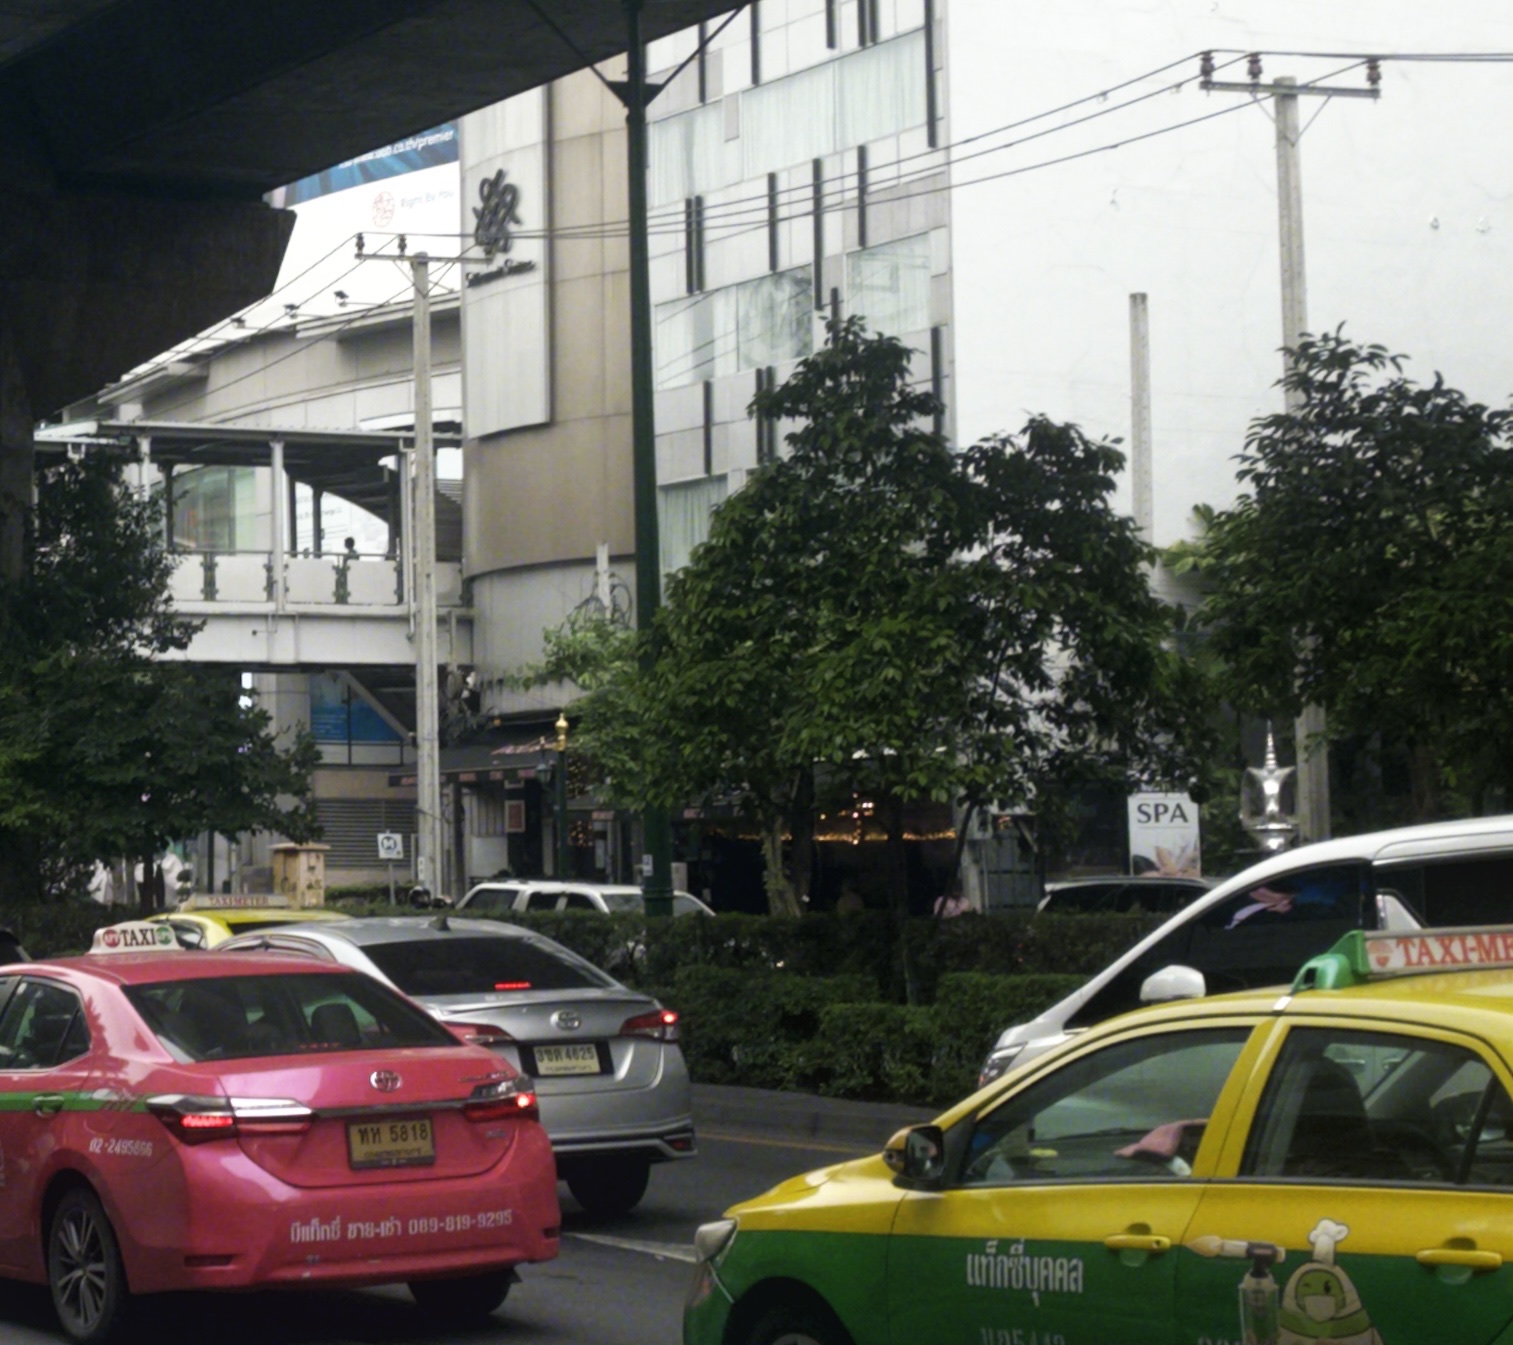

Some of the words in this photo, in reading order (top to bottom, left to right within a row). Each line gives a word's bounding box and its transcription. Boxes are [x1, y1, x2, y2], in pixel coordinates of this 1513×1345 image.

[1137, 802, 1188, 824] SPA
[120, 928, 157, 947] TAXI
[389, 1122, 429, 1143] 5818
[966, 1238, 1083, 1307] แท็กซี่บุคคล
